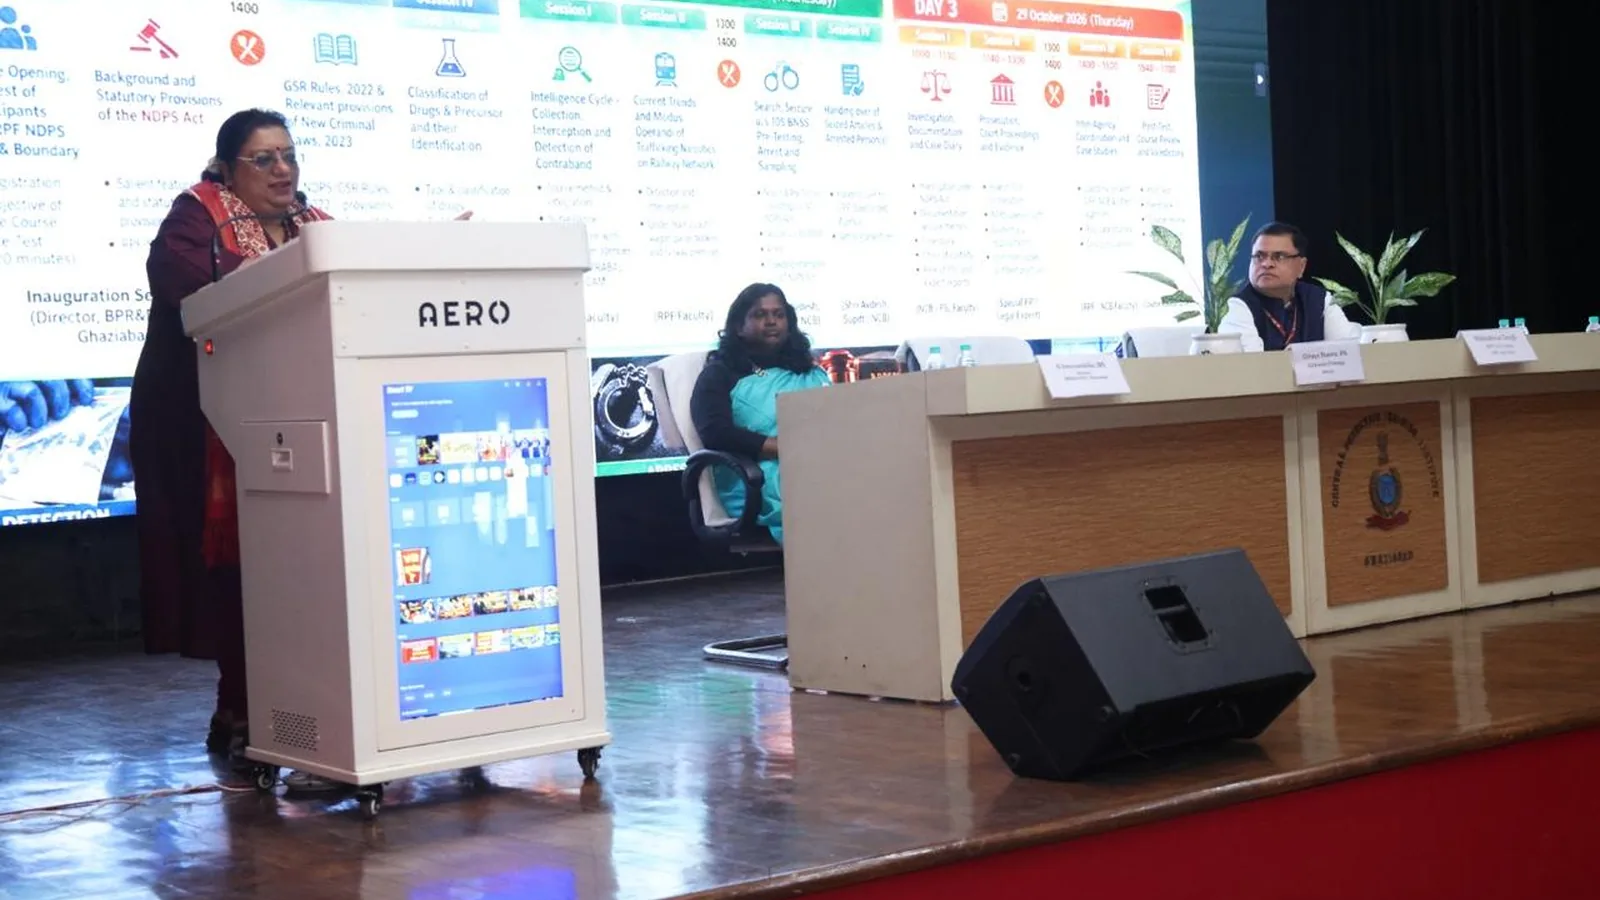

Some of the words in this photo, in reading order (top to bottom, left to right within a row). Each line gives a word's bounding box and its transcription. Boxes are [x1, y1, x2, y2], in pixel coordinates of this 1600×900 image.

[231, 2, 260, 14] 1400
[545, 3, 585, 16] Session
[915, 0, 944, 16] DAY
[948, 1, 958, 18] 3
[716, 18, 736, 29] 1300
[717, 37, 737, 47] 1400
[8, 65, 70, 84] Opening,
[95, 69, 169, 87] Background
[172, 74, 196, 87] and
[22, 84, 37, 98] of
[283, 79, 307, 93] GSR
[347, 83, 375, 96] 2022
[377, 84, 386, 97] &
[407, 86, 475, 101] Classification
[478, 89, 489, 101] of
[96, 88, 157, 106] Statutory
[160, 91, 224, 107] Provisions
[530, 91, 586, 107] Intelligence
[588, 92, 615, 107] Cycle
[632, 94, 667, 107] Current
[668, 96, 697, 108] Trends
[285, 97, 334, 112] Relevant
[337, 101, 394, 114] provisions
[409, 104, 441, 119] Drugs
[443, 105, 452, 117] &
[454, 106, 504, 119] Precursor
[98, 107, 111, 121] of
[115, 109, 137, 122] the
[141, 110, 180, 124] NDPS
[183, 112, 205, 124] Act
[634, 110, 651, 122] and
[652, 111, 684, 123] Modus
[25, 123, 66, 138] NDPS
[301, 116, 326, 129] New
[329, 117, 376, 132] Criminal
[410, 122, 431, 133] and
[433, 121, 457, 133] their
[532, 124, 592, 138] Interception
[594, 126, 612, 138] and
[294, 134, 321, 148] aws,
[324, 135, 353, 148] 2023
[411, 137, 483, 152] Identification
[534, 140, 582, 154] Detection
[584, 142, 594, 154] of
[14, 142, 80, 160] Boundary
[535, 157, 593, 171] Contraband
[26, 289, 130, 307] Inauguration
[30, 310, 101, 327] (Director,
[419, 300, 510, 327] AERO
[585, 313, 620, 324] aculty)
[77, 329, 147, 344] Ghaziaba
